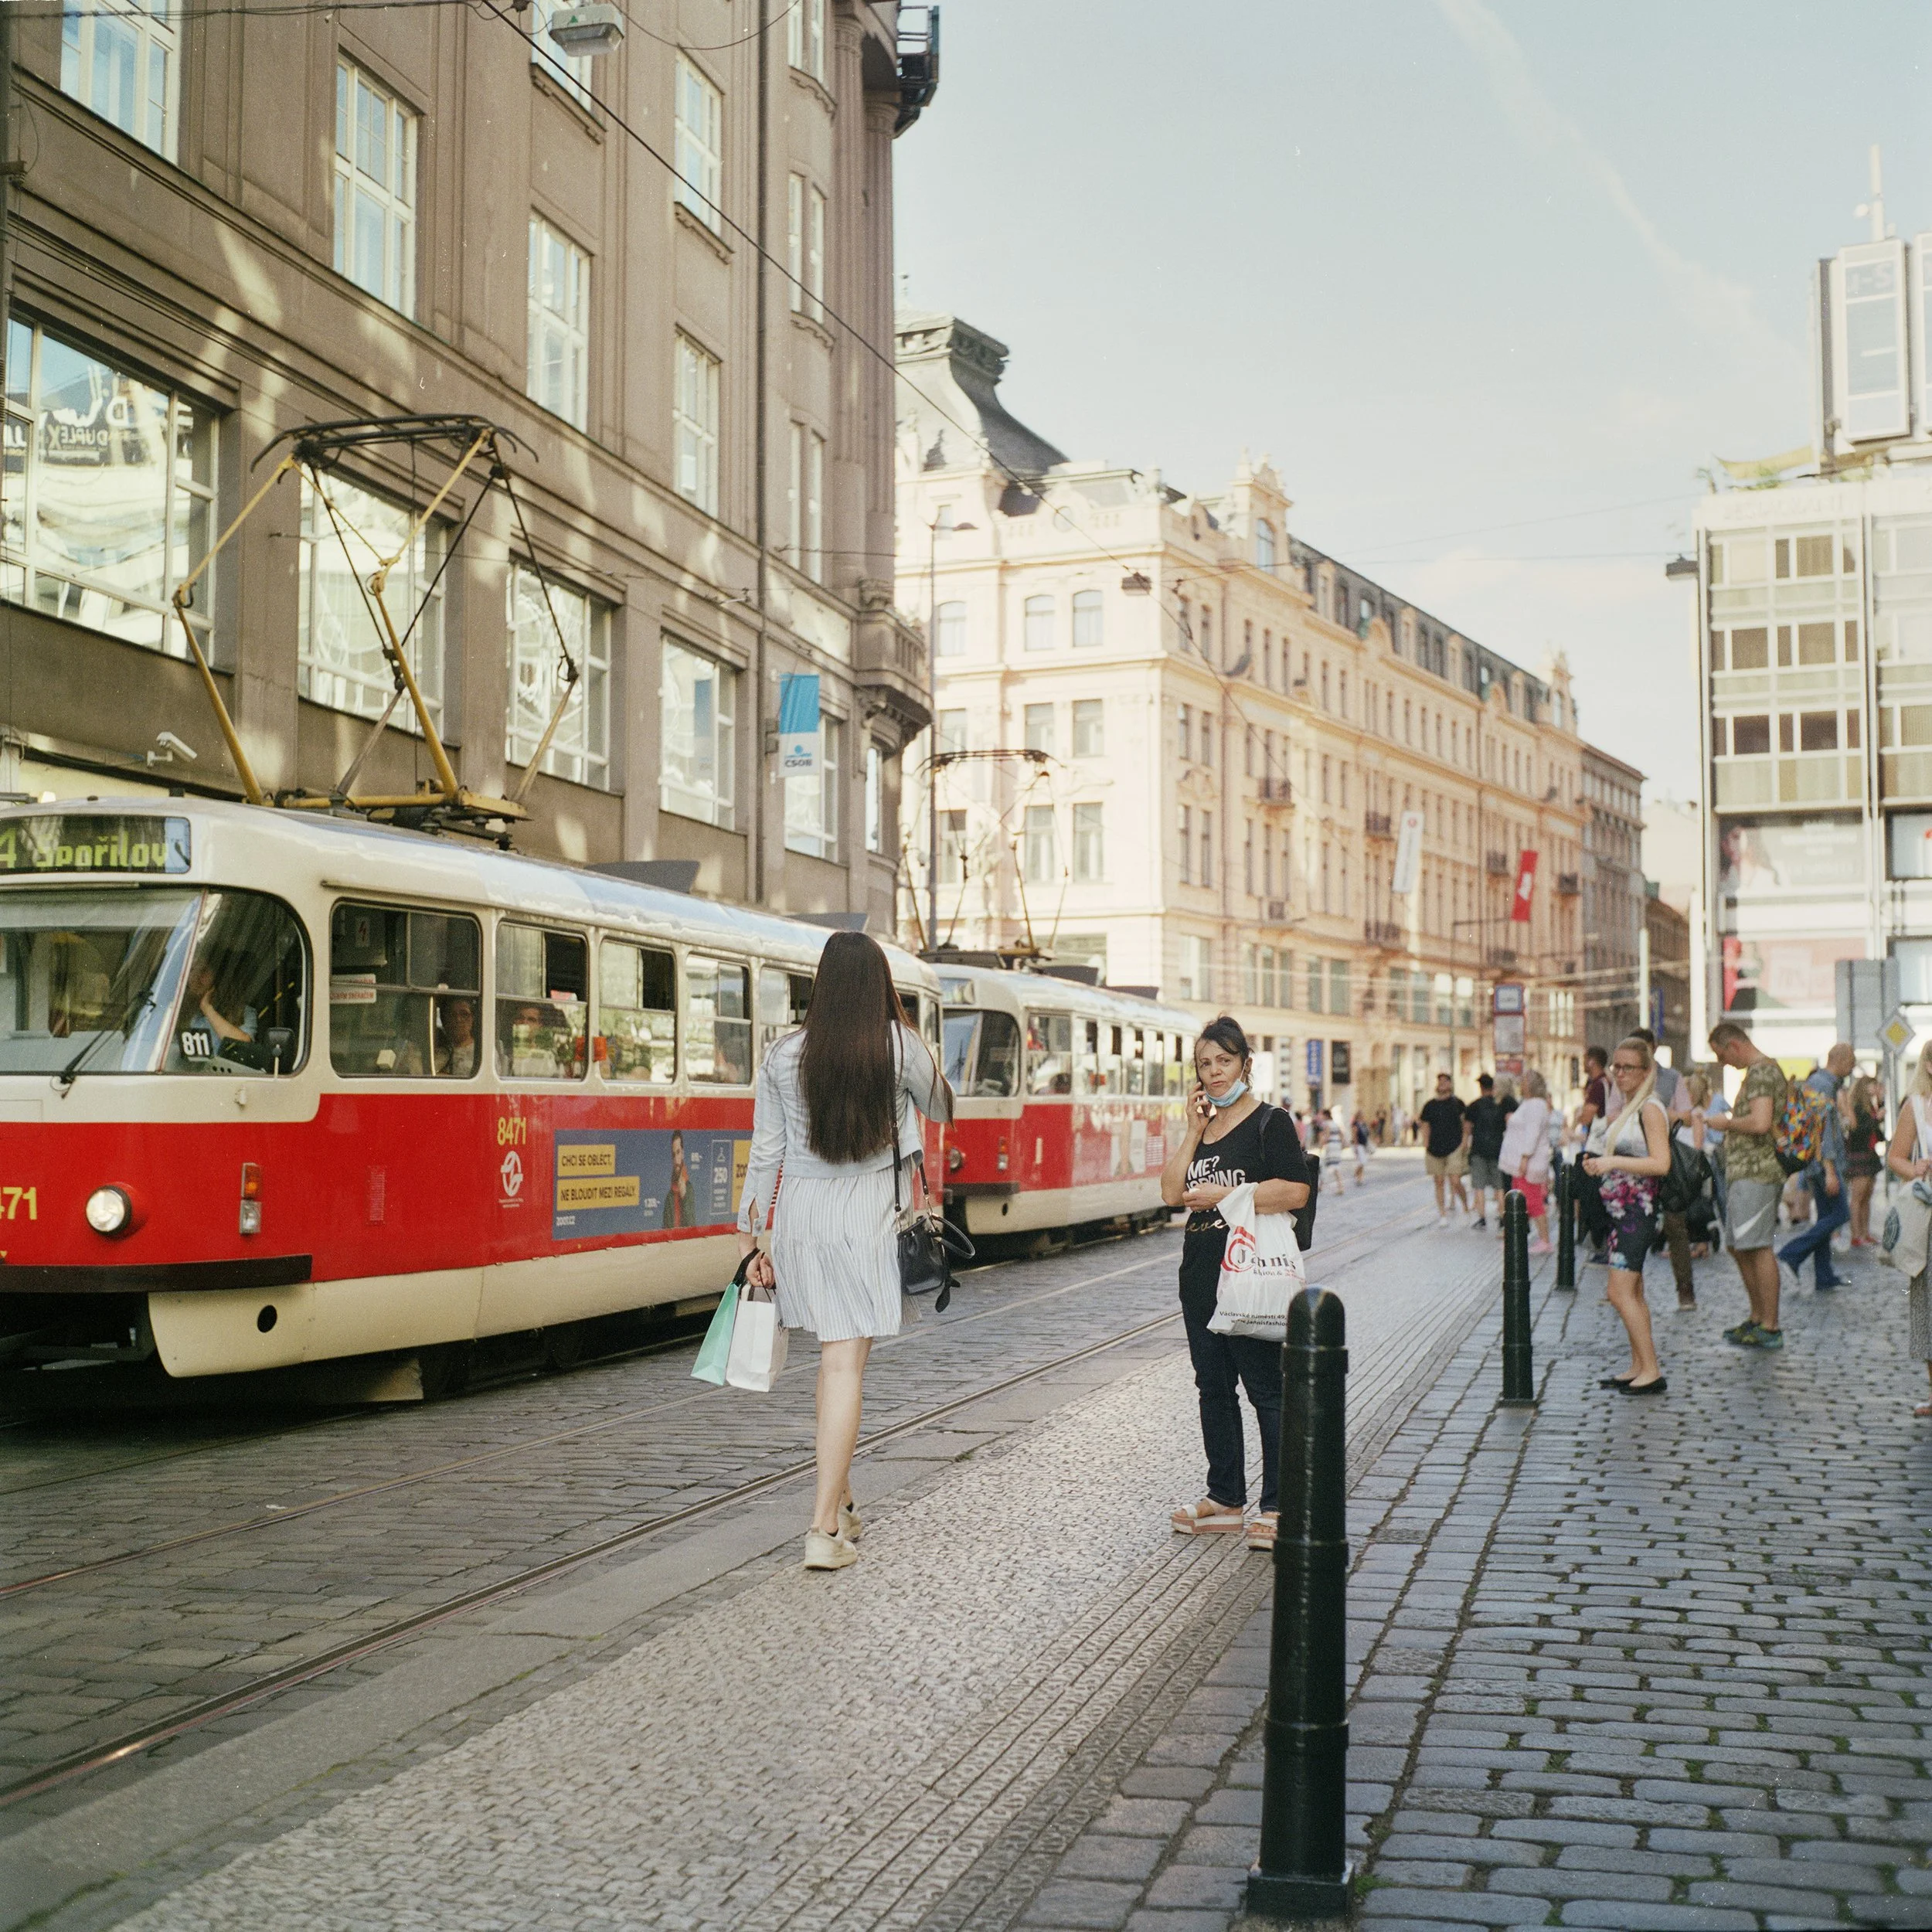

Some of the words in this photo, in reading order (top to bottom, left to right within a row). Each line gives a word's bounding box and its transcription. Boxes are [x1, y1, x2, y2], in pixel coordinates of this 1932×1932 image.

[35, 830, 167, 868] Spořilov
[182, 1031, 210, 1056] 811
[497, 1117, 526, 1146] 8471
[561, 1155, 577, 1167] CHCI
[578, 1154, 587, 1166] SE
[1187, 1155, 1220, 1181] ME?
[0, 1185, 38, 1220] 71
[560, 1189, 570, 1201] NE
[570, 1187, 597, 1201] BLOUDIT
[598, 1186, 613, 1199] MEZI
